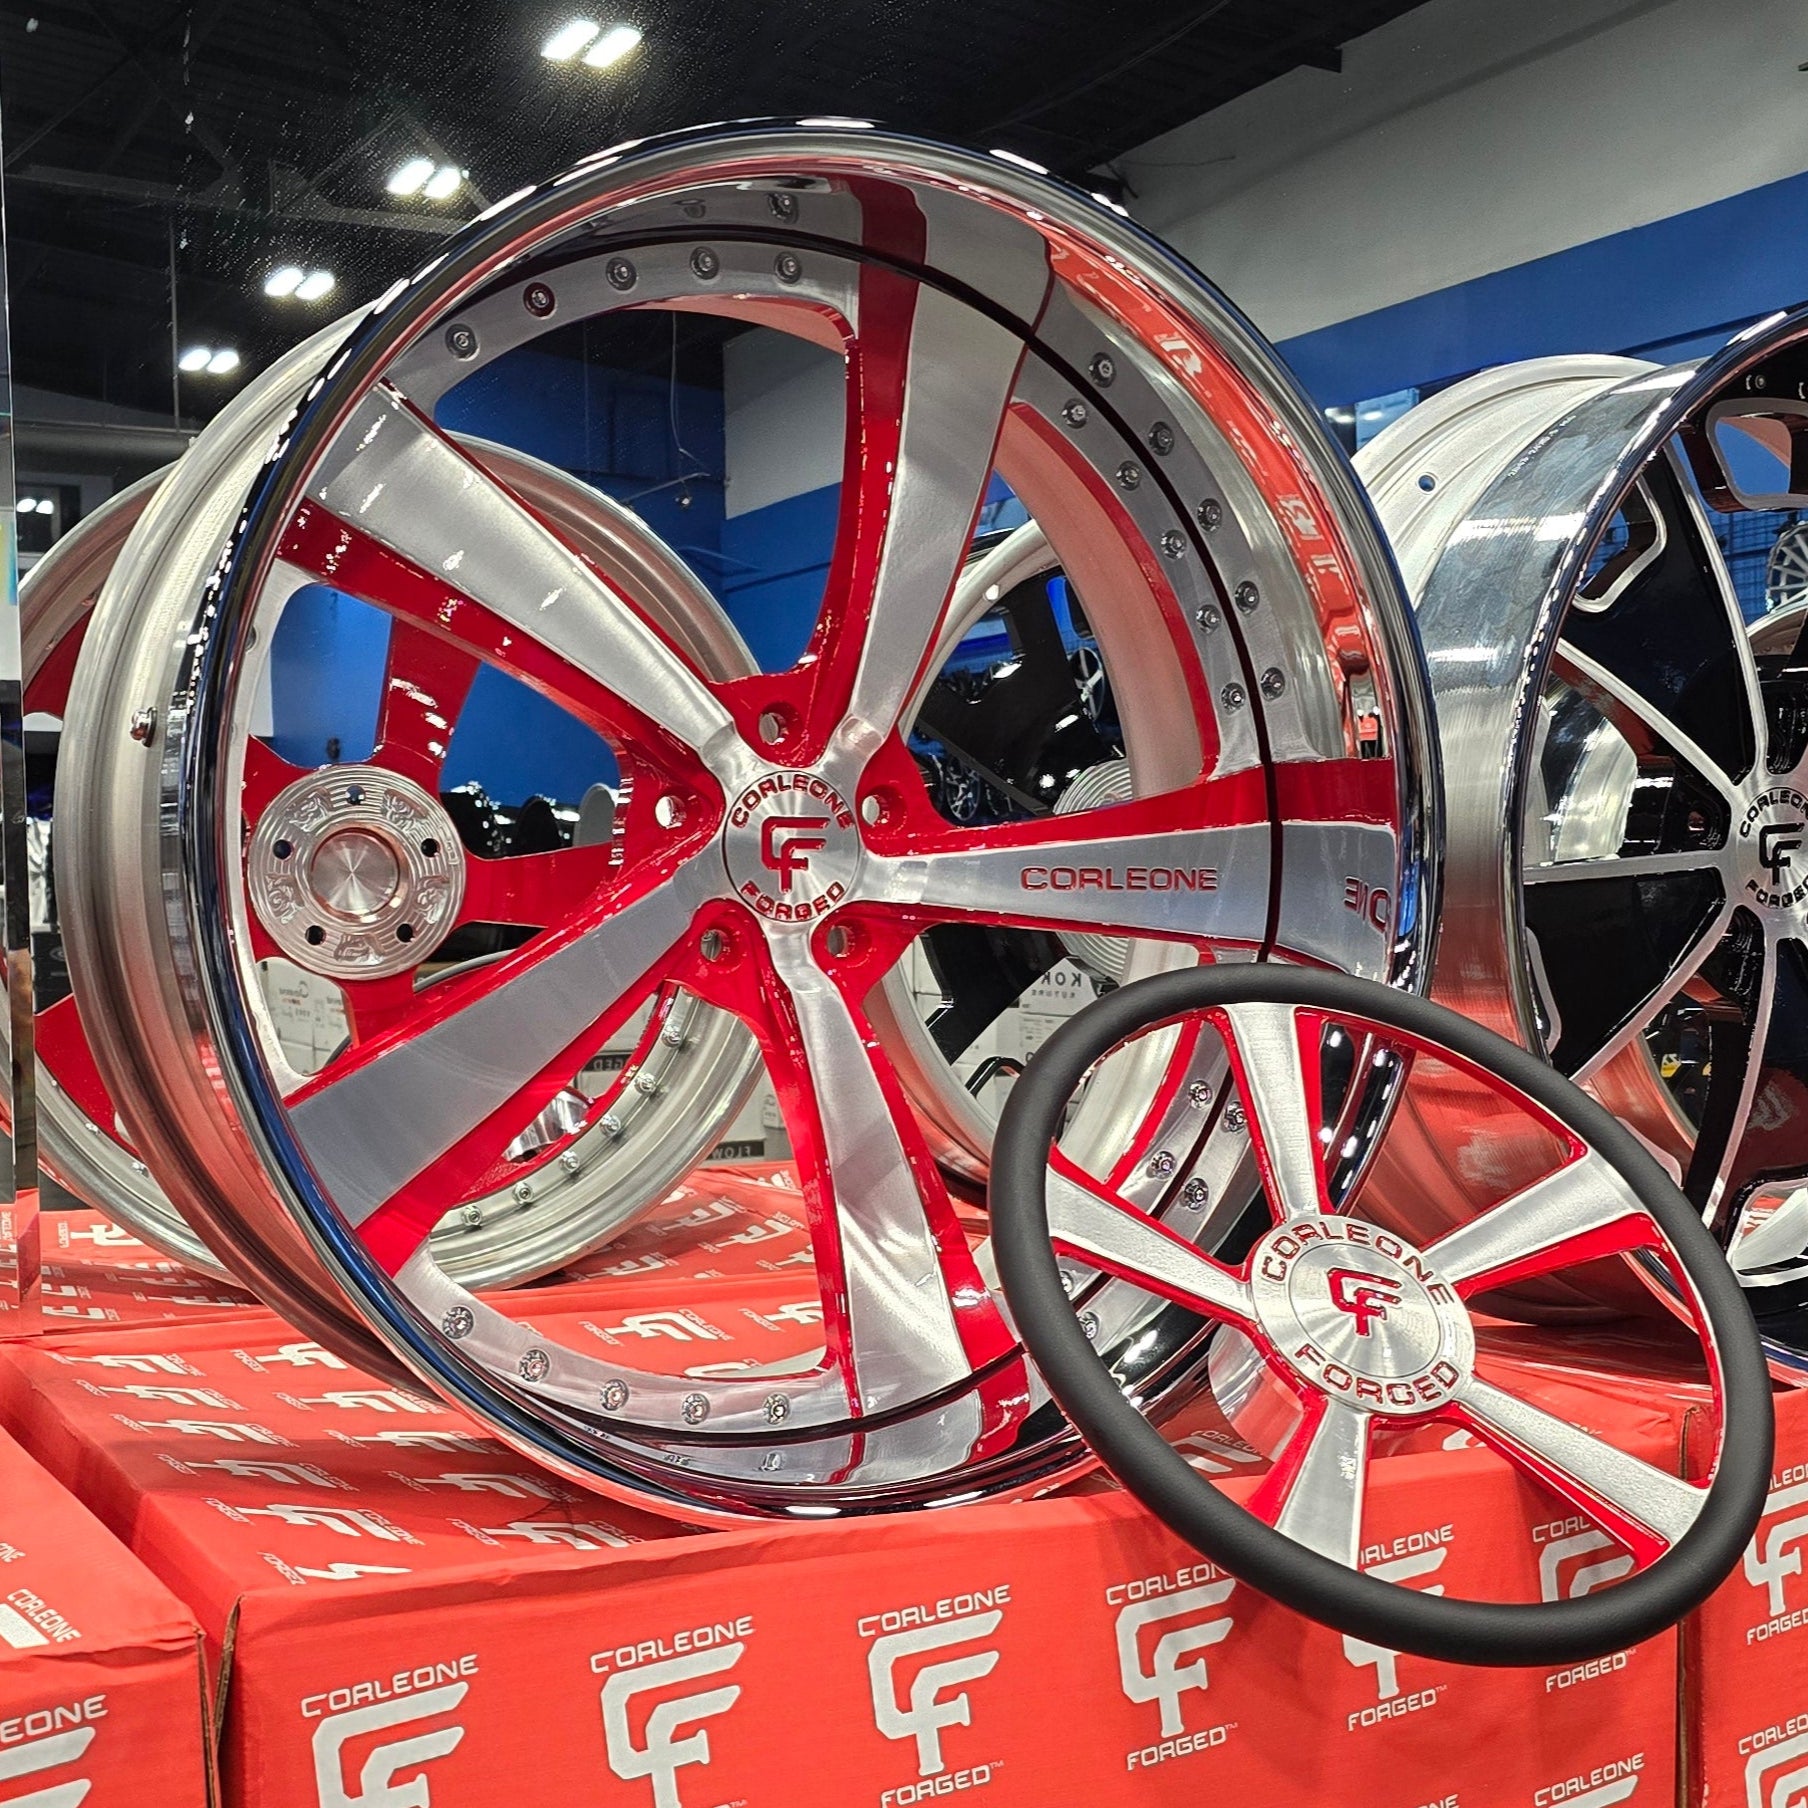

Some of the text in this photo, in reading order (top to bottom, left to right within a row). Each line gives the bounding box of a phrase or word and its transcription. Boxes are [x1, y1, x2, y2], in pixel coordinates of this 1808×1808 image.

[731, 774, 856, 831] CORLEONE
[740, 880, 846, 920] FORGED
[1021, 866, 1218, 893] CORLEONE
[1262, 1221, 1456, 1306] CORLEONE
[1295, 1343, 1459, 1407] FORGED
[7, 1588, 82, 1643] CORLEONE
[858, 1583, 1012, 1638] CORLEONE
[590, 1615, 755, 1674] CORLEONE
[301, 1653, 480, 1718] CORLEONE
[1534, 1752, 1645, 1808] CORLEONE
